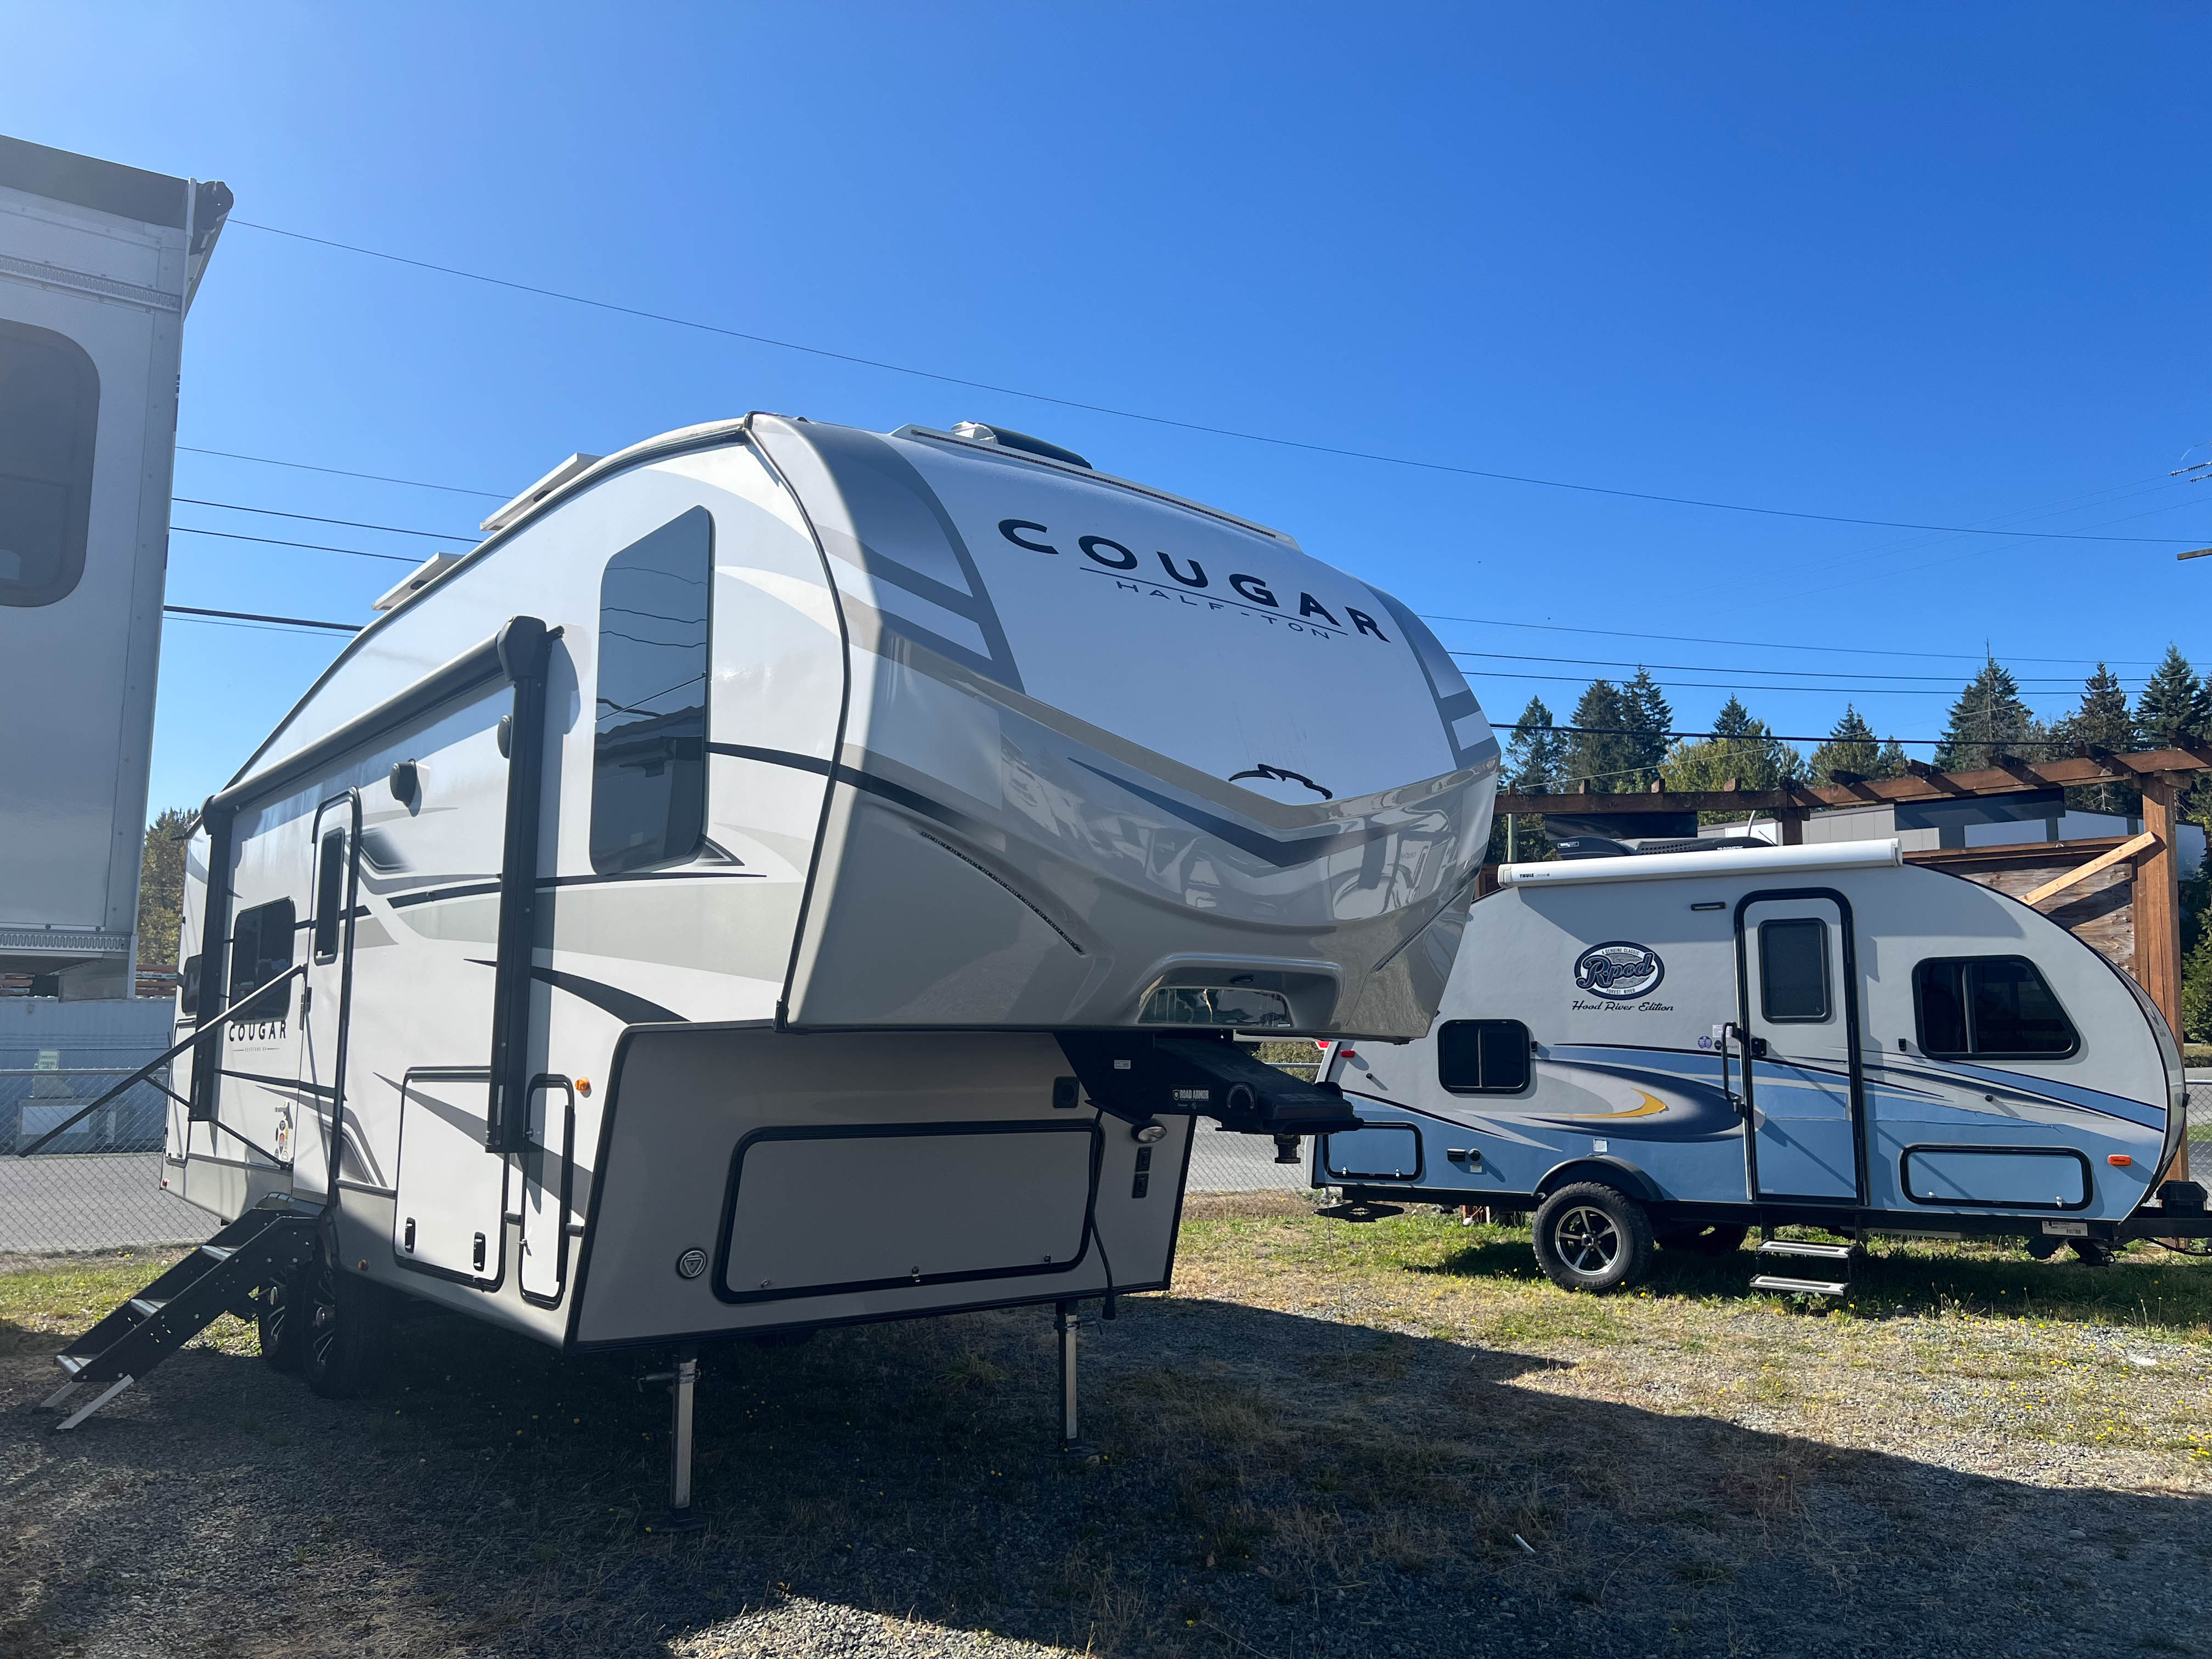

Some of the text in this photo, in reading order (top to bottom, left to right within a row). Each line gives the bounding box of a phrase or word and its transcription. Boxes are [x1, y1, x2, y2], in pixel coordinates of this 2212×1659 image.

[998, 518, 1391, 643] COUGAR
[1572, 1000, 1674, 1012] Hood River Edition
[229, 1019, 286, 1042] COUGAR
[1180, 1090, 1209, 1099] ROAD ARMOR
